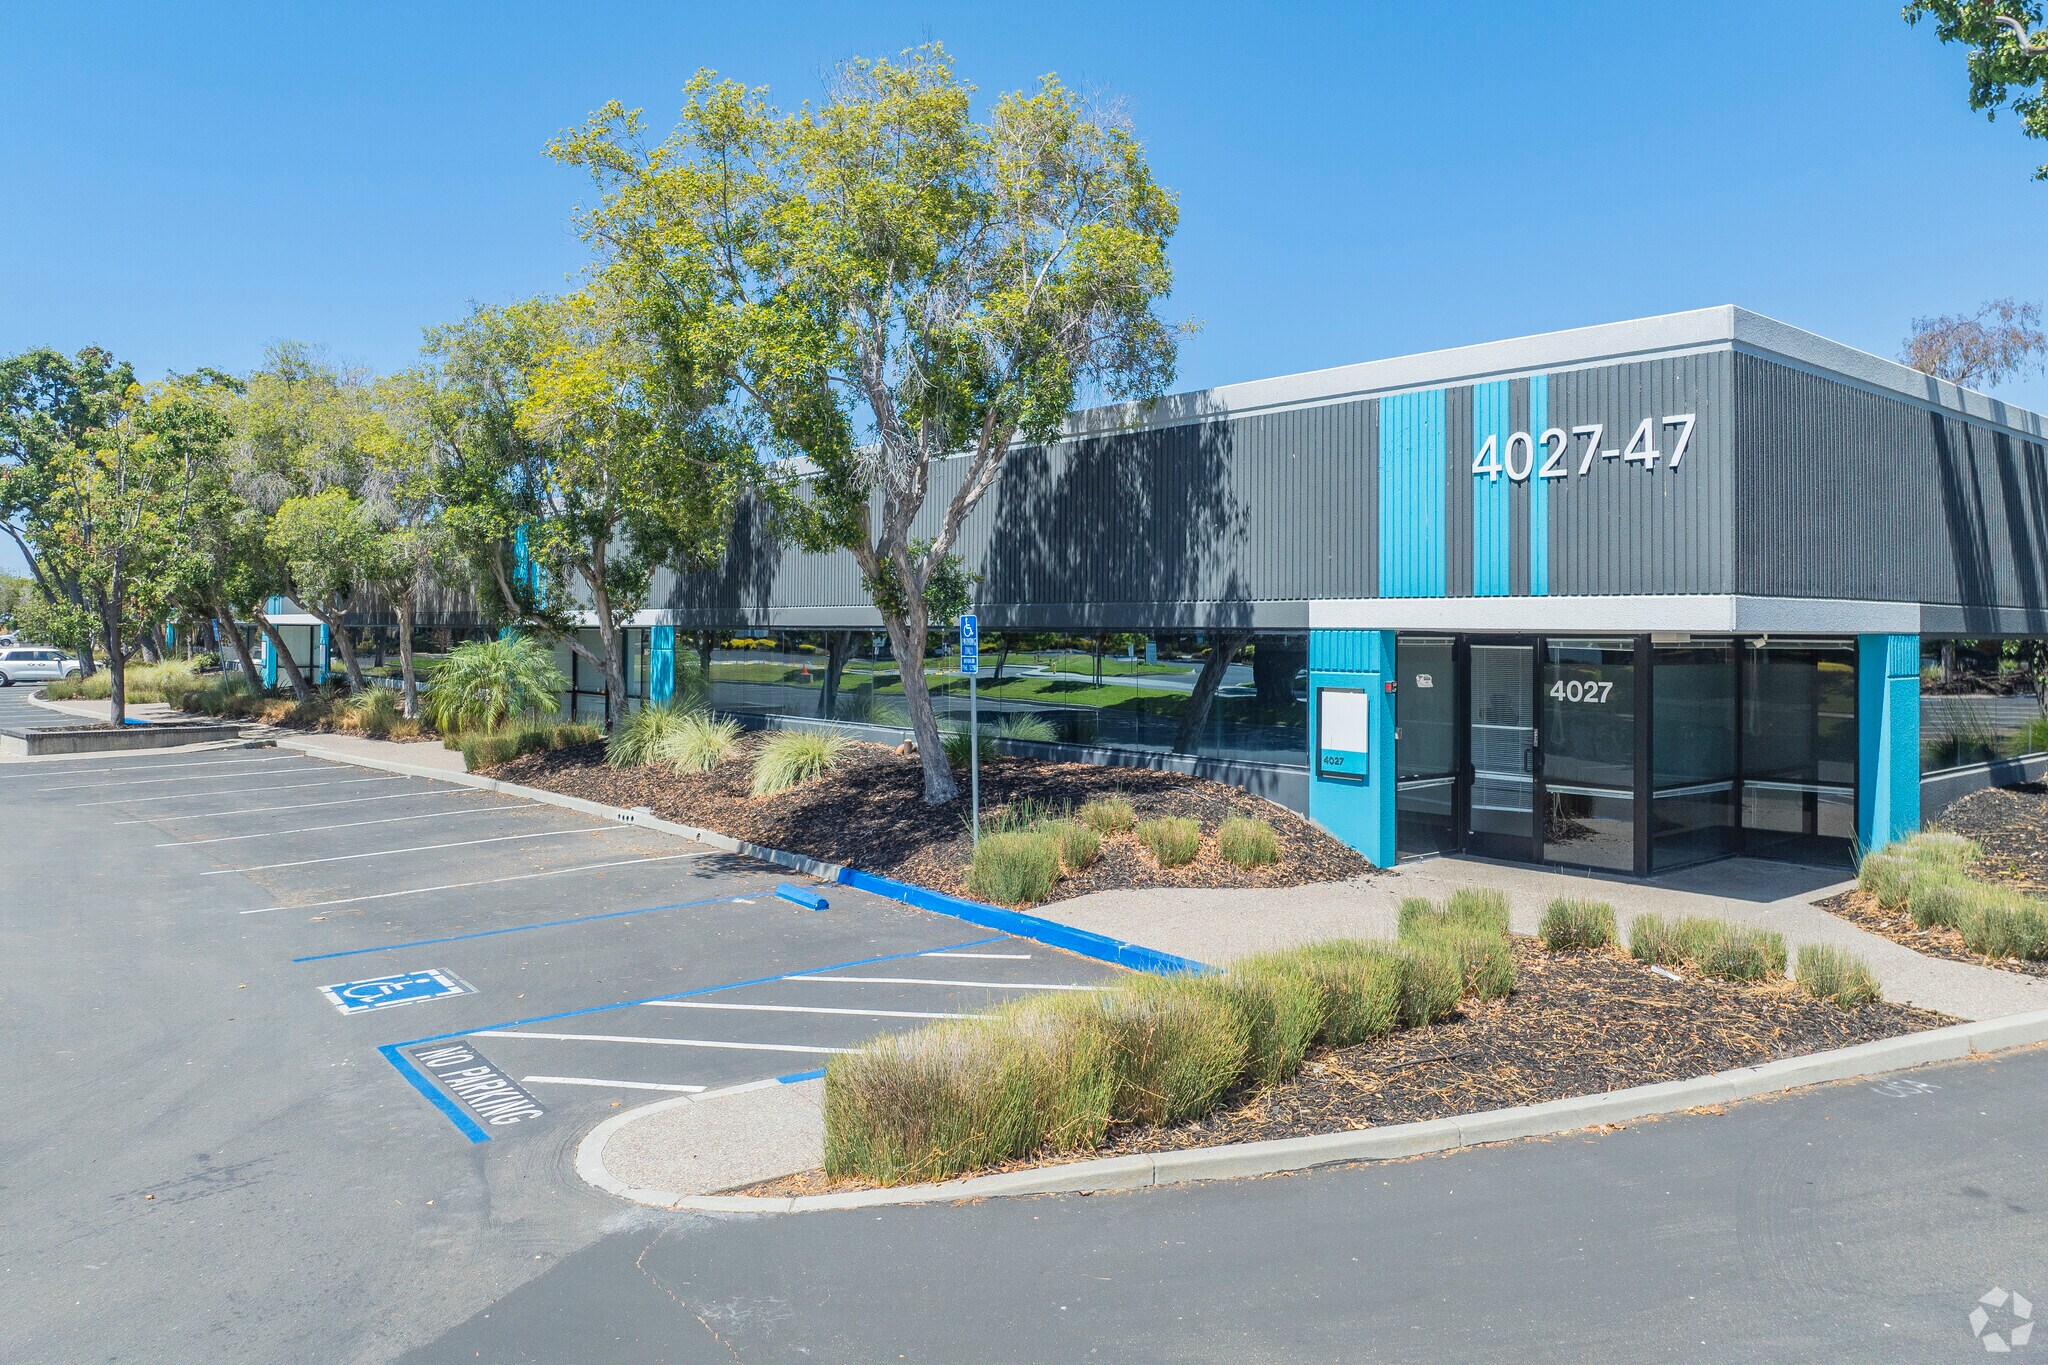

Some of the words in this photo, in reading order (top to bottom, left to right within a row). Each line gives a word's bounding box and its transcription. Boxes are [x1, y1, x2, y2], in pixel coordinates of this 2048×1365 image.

[1471, 413, 1696, 482] 4027-47
[1549, 680, 1614, 703] 4027
[1323, 755, 1345, 766] 4027
[415, 1045, 475, 1068] NO
[437, 1065, 544, 1126] PARKING
